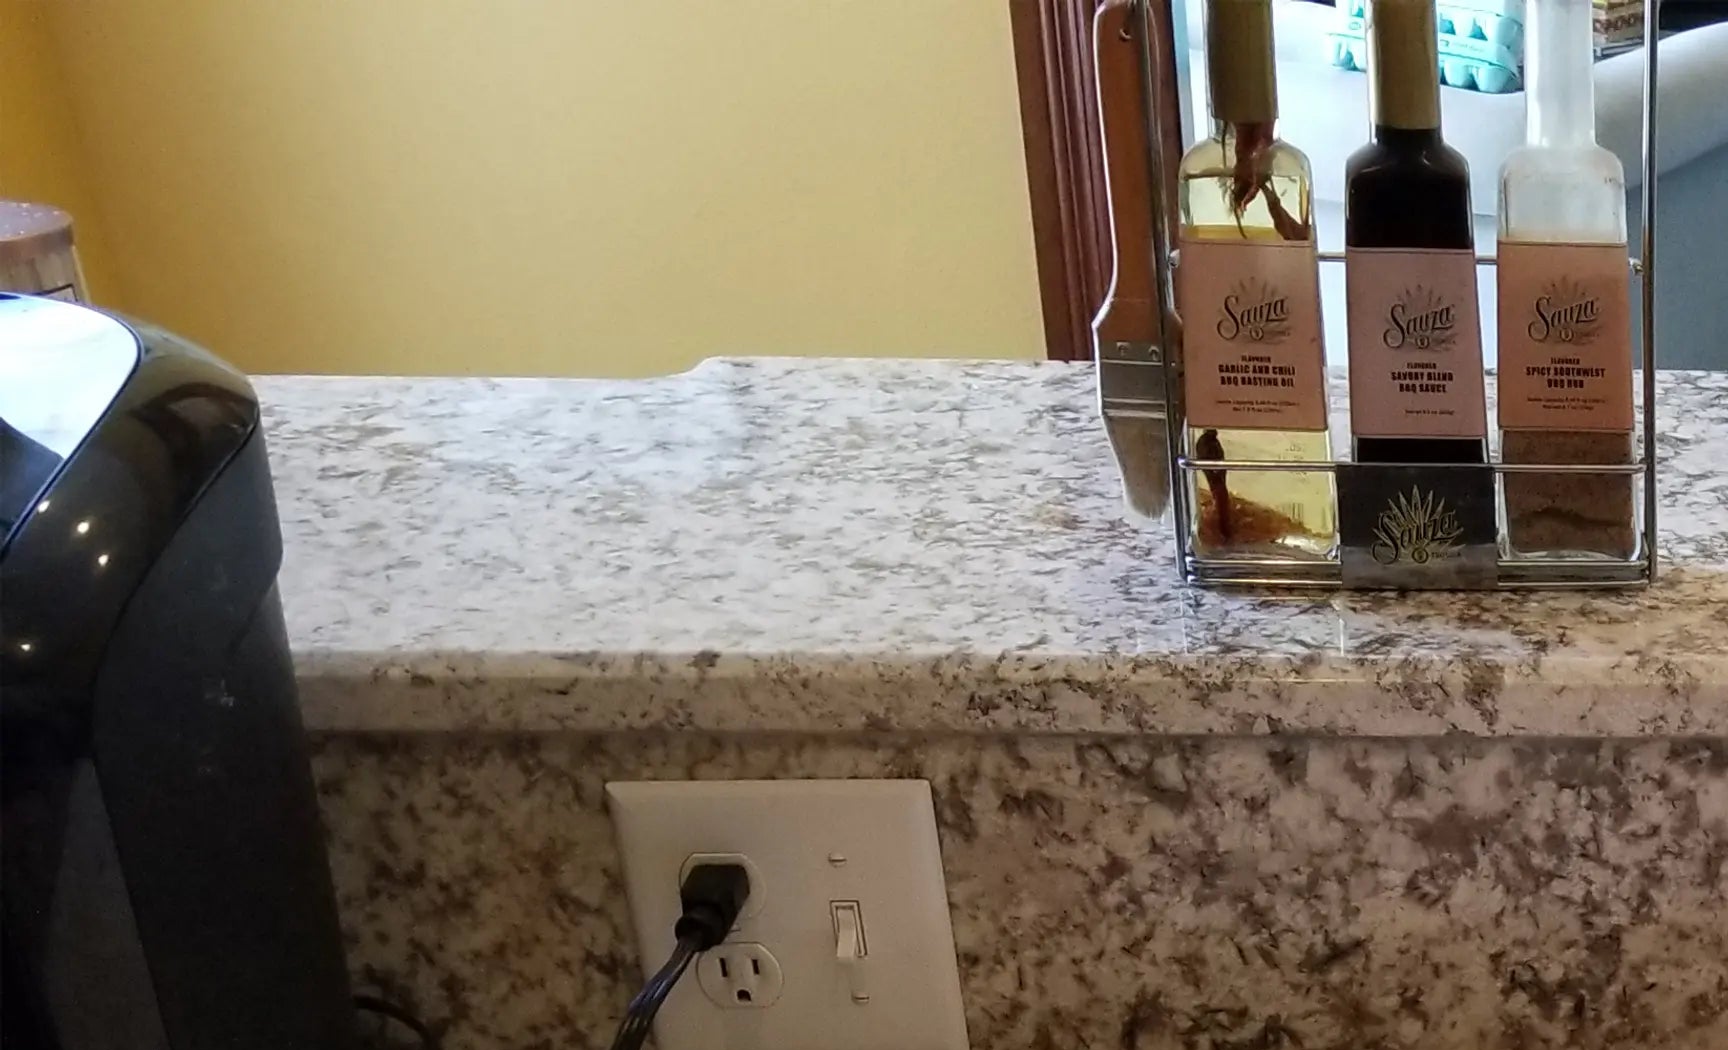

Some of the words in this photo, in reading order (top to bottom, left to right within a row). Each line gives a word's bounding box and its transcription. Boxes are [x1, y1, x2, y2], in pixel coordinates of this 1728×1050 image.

[1217, 295, 1289, 340] Sauza
[1528, 296, 1599, 342] Sauza
[1383, 303, 1455, 349] Sauza
[1218, 364, 1250, 374] GARLIC
[1272, 366, 1296, 376] CHILI
[1526, 366, 1551, 376] SPICY
[1554, 367, 1605, 377] SOUTHWEST
[1391, 371, 1425, 381] SAVORY
[1281, 378, 1294, 388] OIL
[1399, 383, 1417, 394] BBQ
[1419, 384, 1447, 394] SAUCE
